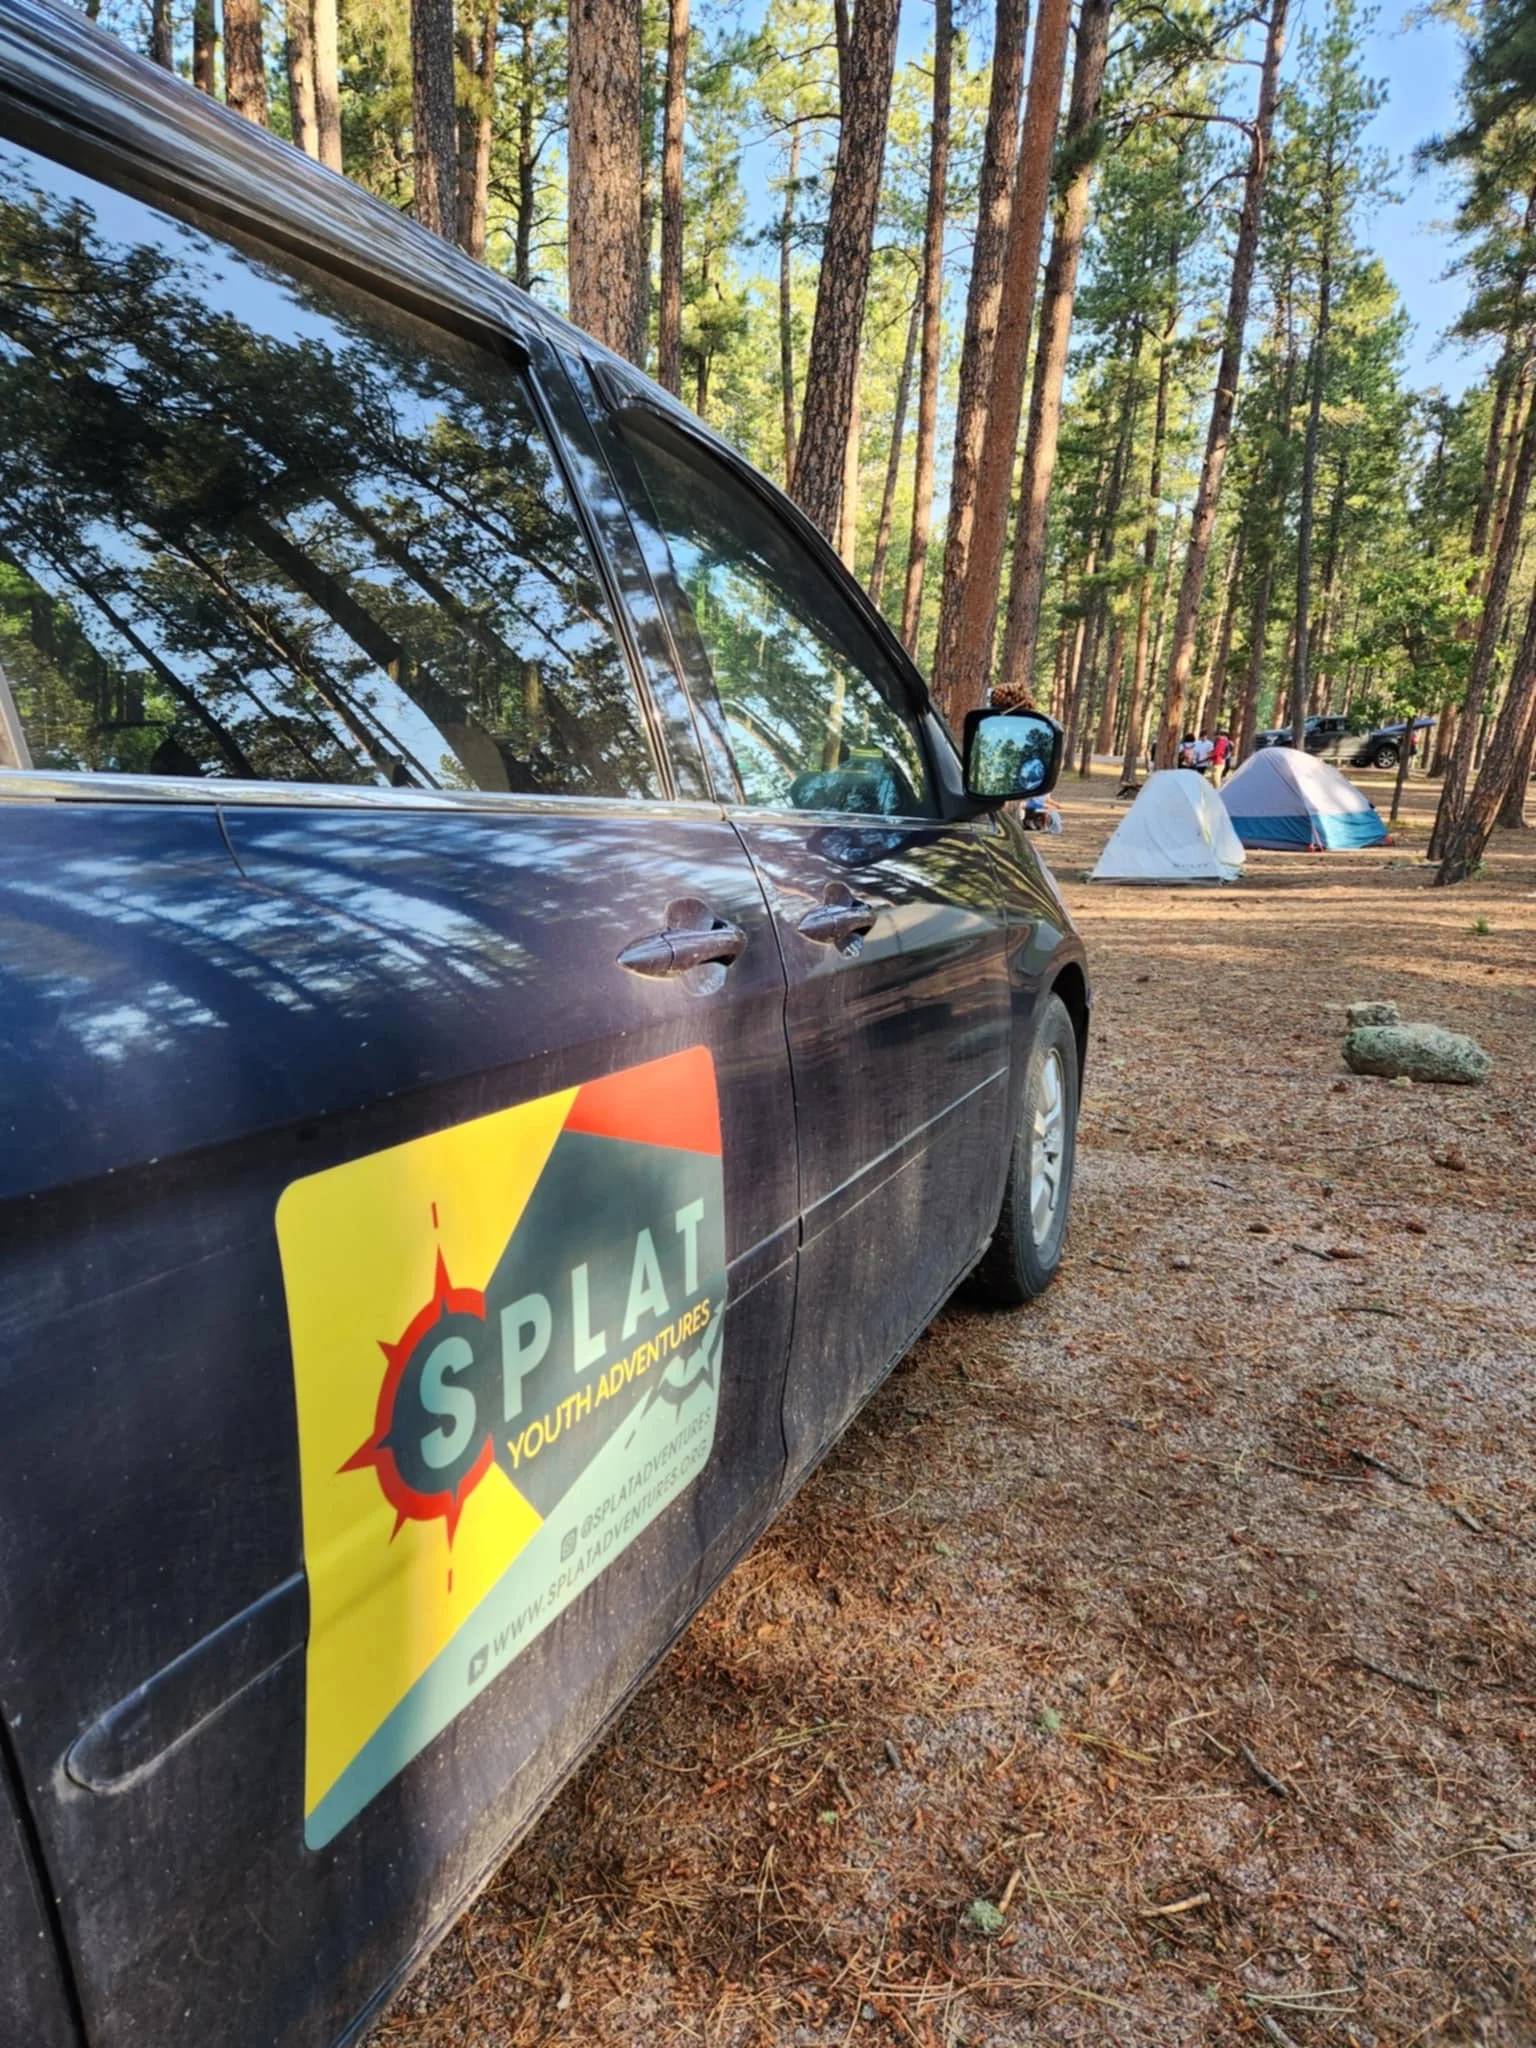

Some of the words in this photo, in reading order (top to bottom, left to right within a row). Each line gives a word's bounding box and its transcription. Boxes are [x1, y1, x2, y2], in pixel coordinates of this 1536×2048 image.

[421, 1197, 705, 1470] SPLAT
[507, 1384, 593, 1470] YOUTH
[594, 1298, 711, 1410] ADVENTURES
[492, 1438, 708, 1657] WWW.SPLATADVENTURES.ORG
[580, 1405, 712, 1540] @SPLATADVENTURES
